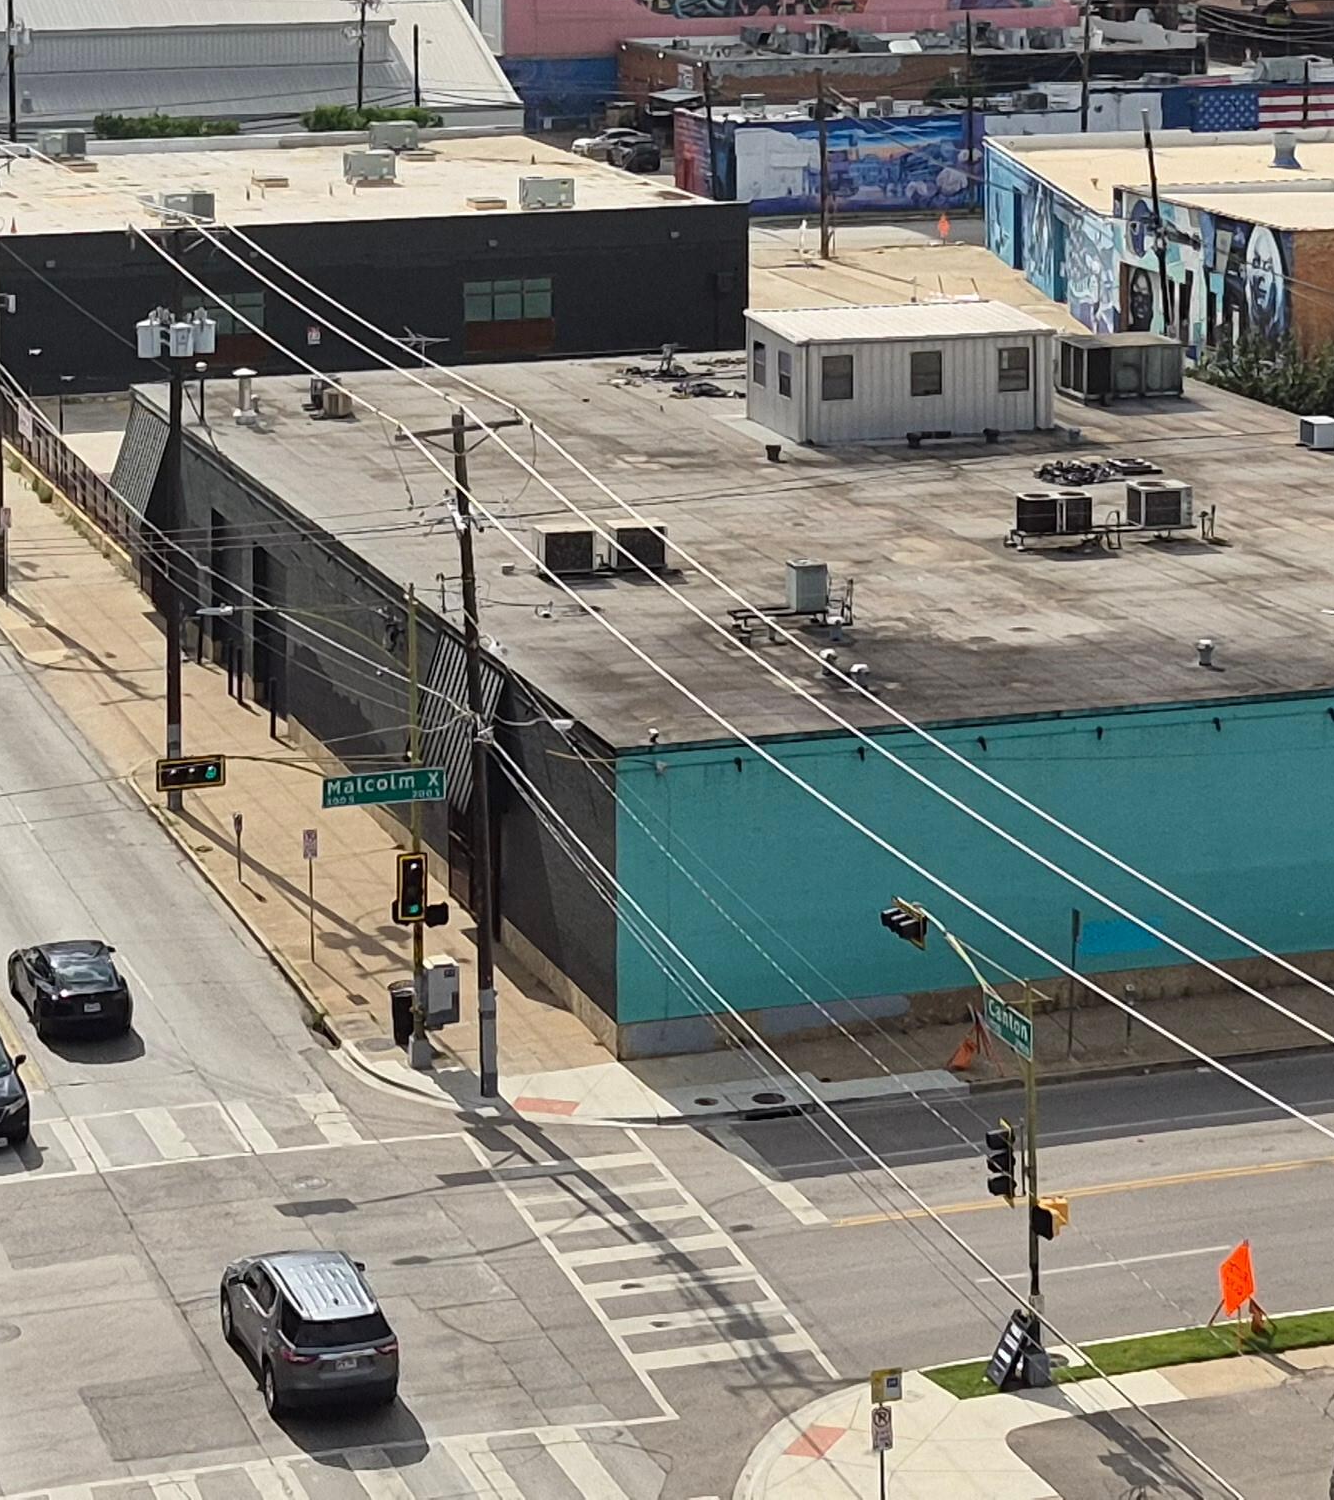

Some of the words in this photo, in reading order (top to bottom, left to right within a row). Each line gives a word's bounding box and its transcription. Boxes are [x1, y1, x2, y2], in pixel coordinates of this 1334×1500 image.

[327, 774, 415, 796] Malcolm
[428, 771, 439, 787] X
[988, 999, 1029, 1042] Canton
